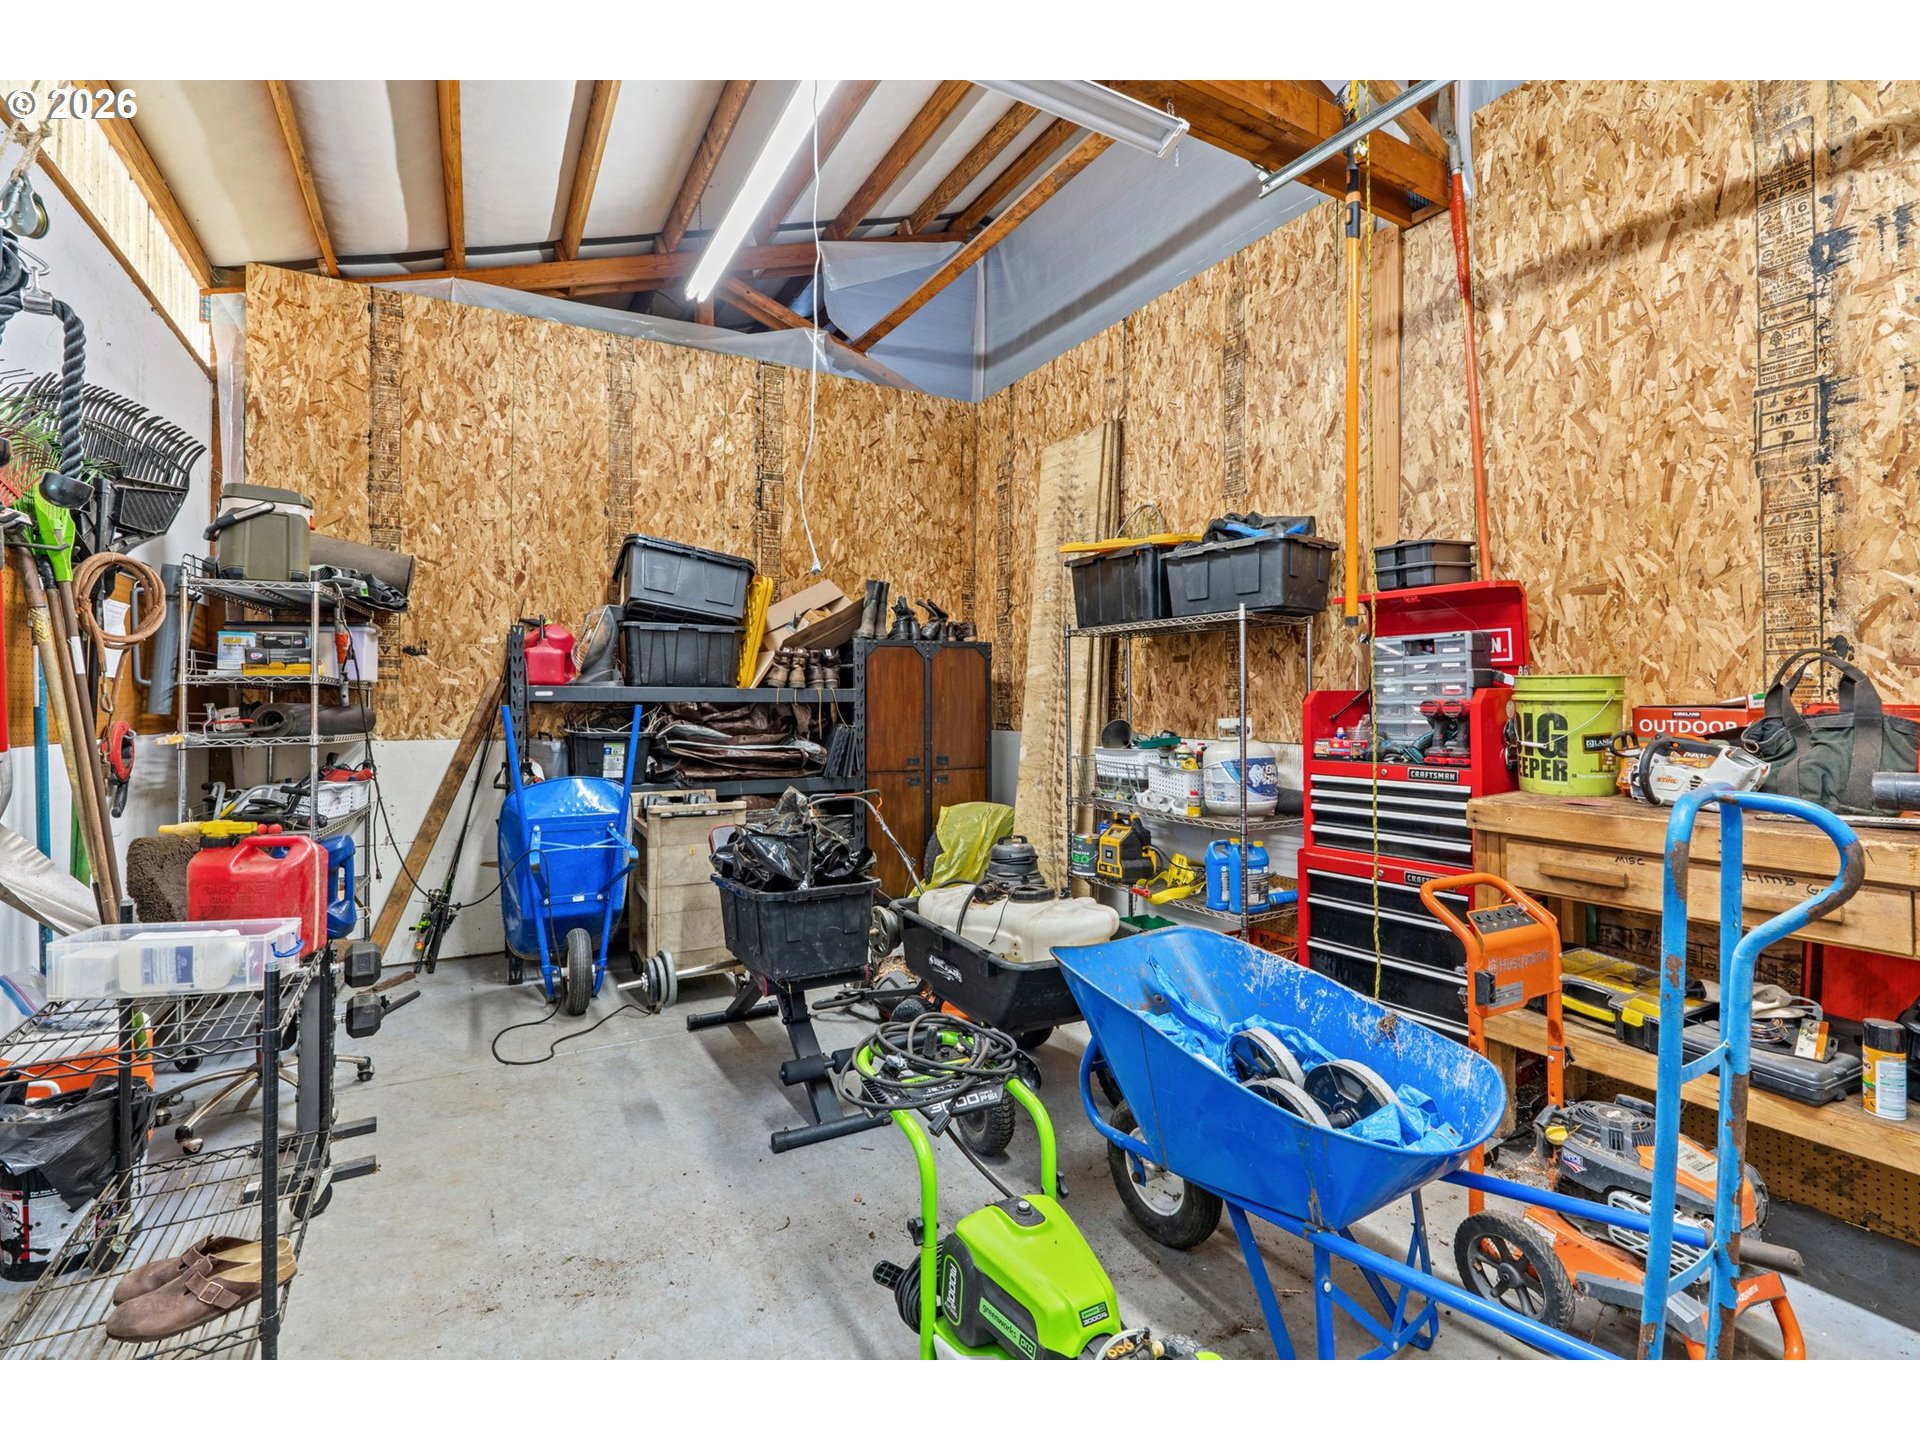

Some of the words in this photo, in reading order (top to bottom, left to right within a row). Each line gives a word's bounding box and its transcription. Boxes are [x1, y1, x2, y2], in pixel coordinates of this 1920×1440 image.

[1763, 201, 1808, 226] 24/16
[1768, 510, 1814, 525] APA
[1768, 532, 1814, 547] 24/16
[1410, 770, 1457, 781] CRAFTSMAN
[1656, 776, 1679, 784] STIHL
[1614, 855, 1646, 866] MISC
[1742, 871, 1797, 886] LIMB
[979, 1092, 998, 1102] PSI
[982, 1304, 1017, 1339] greenworks
[1020, 1337, 1034, 1354] pro
